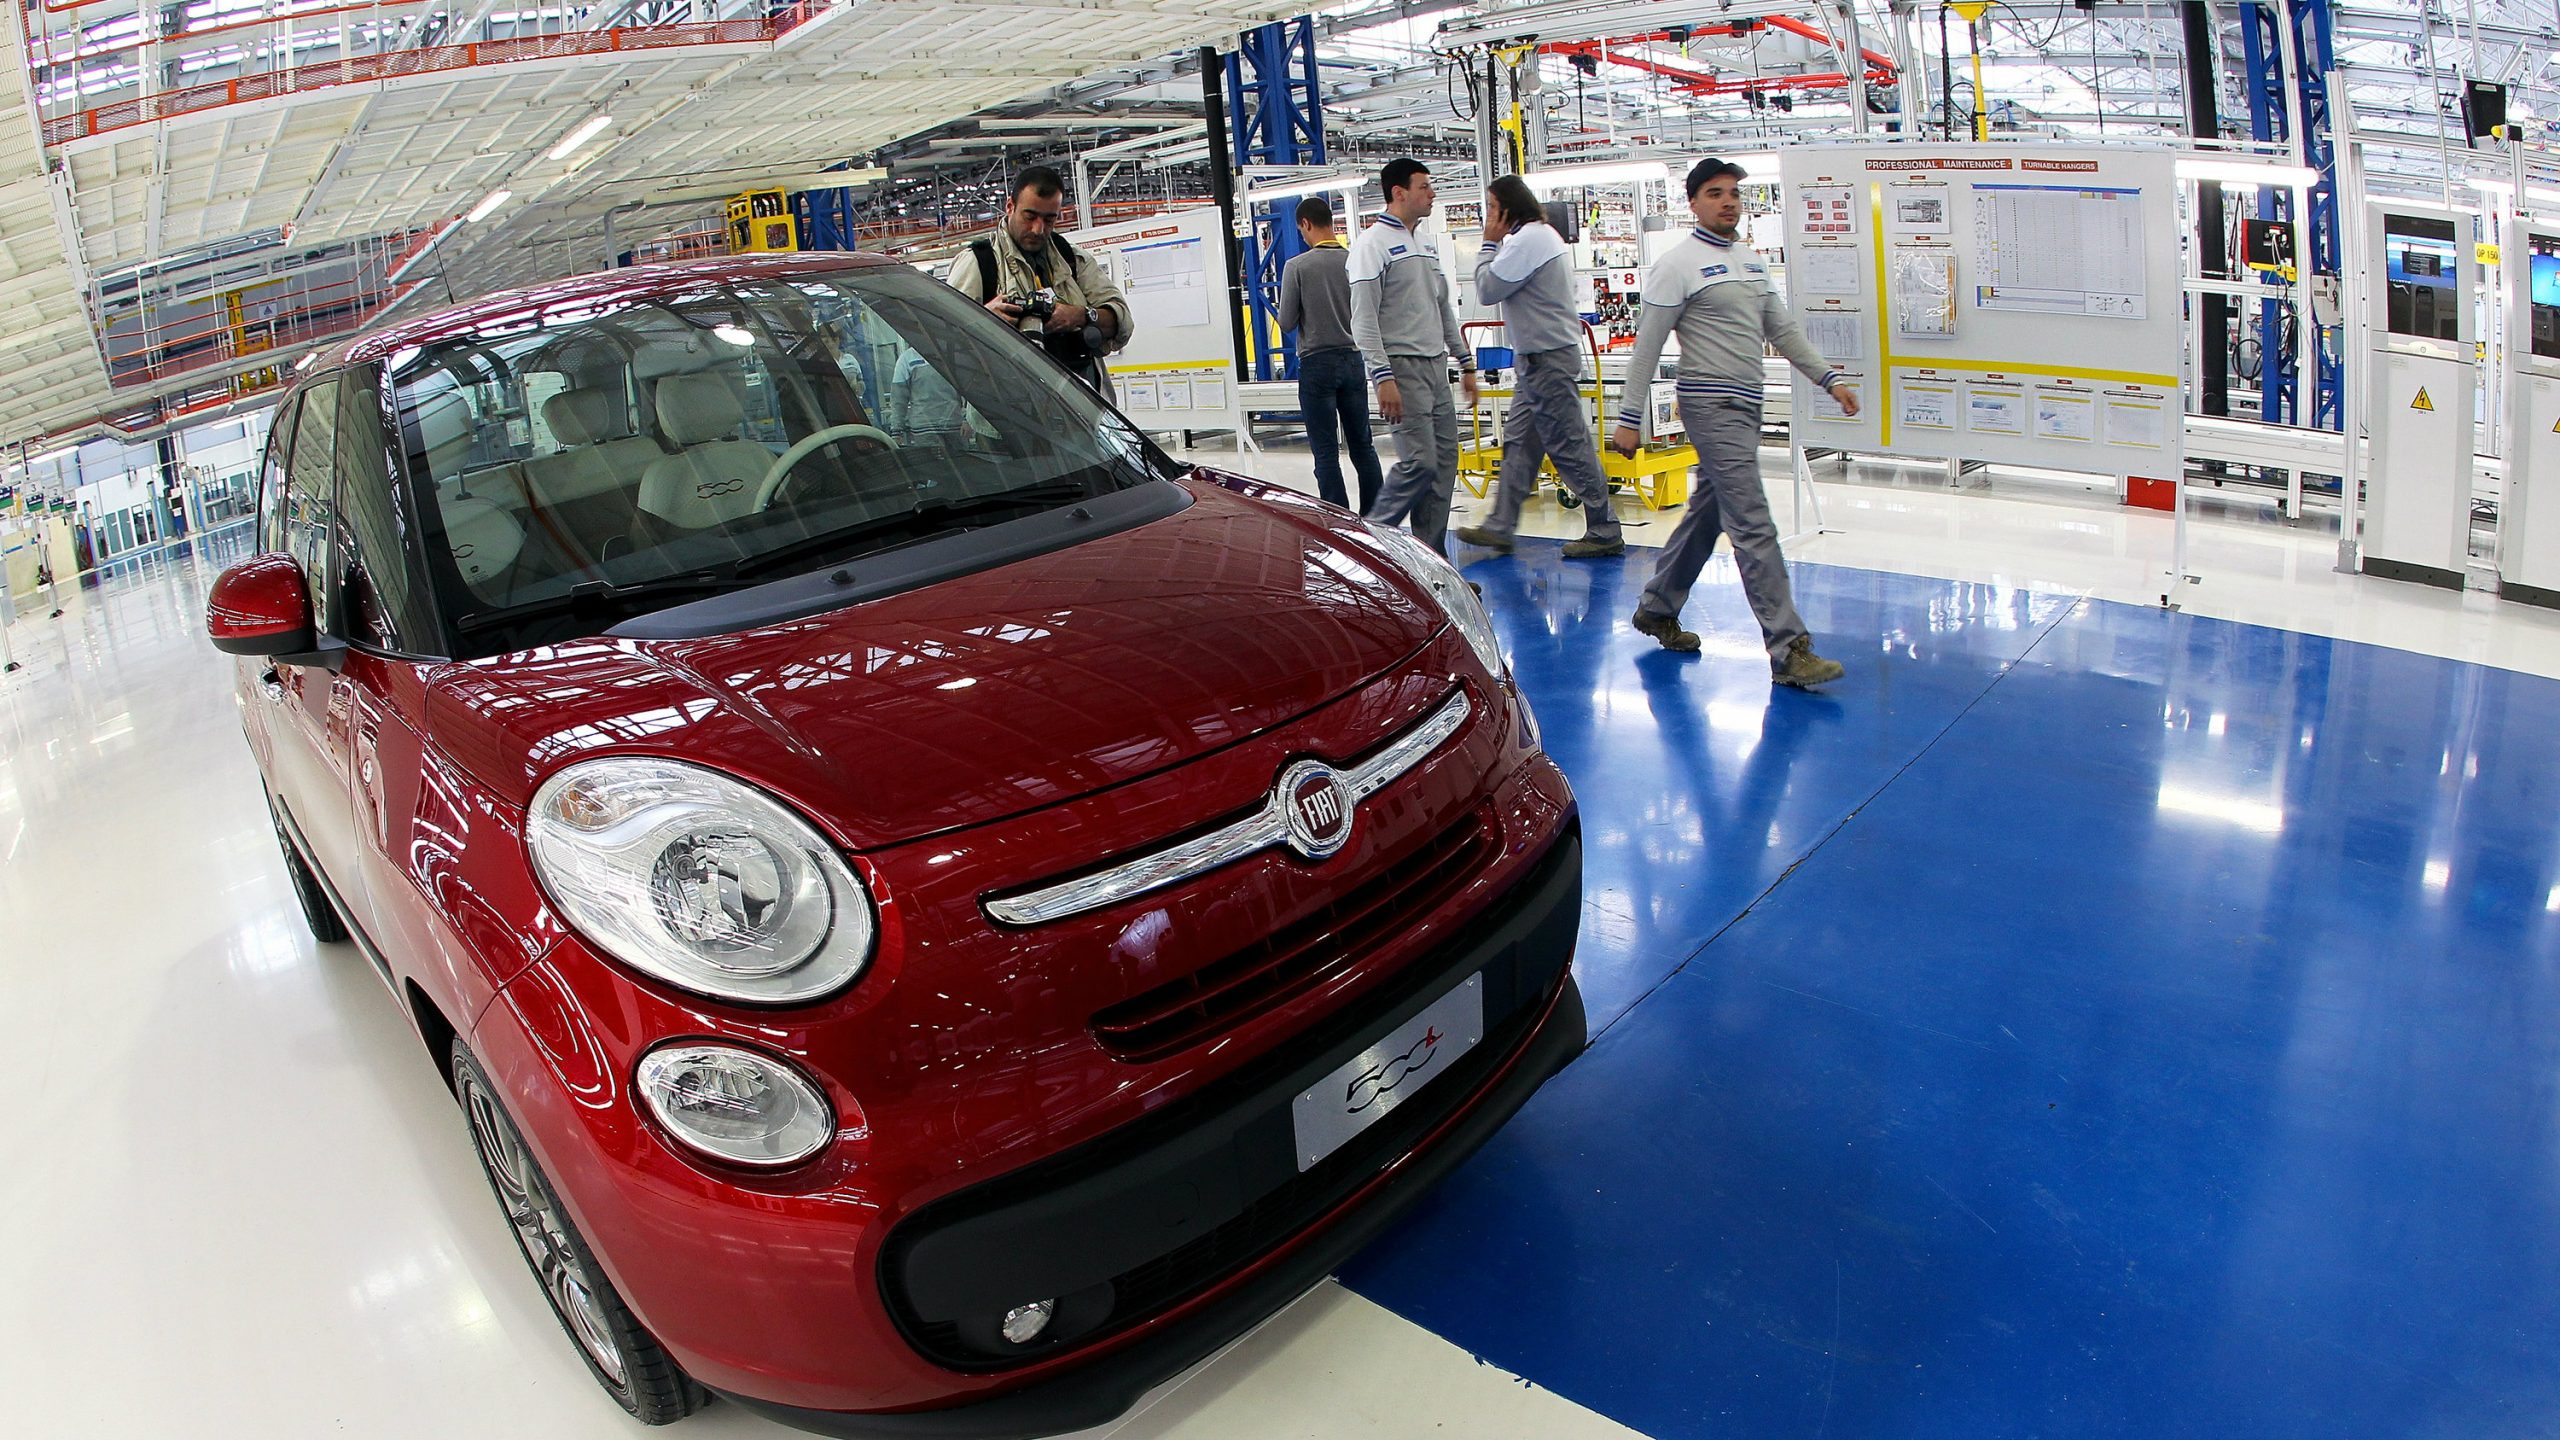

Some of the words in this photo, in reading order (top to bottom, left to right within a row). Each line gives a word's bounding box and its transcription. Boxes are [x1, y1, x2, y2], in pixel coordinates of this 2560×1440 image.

[1866, 160, 1938, 170] PROFESSIONAL
[1943, 160, 2007, 169] MAINTENANCE
[2023, 161, 2060, 170] TURNABLE
[2061, 163, 2096, 171] HANGERS
[2476, 248, 2486, 258] OP
[2487, 250, 2499, 261] 150
[1624, 273, 1636, 285] 8
[31, 484, 37, 492] 3
[697, 479, 744, 499] 500
[1301, 785, 1341, 831] FIAT
[1346, 1025, 1444, 1114] 500L
